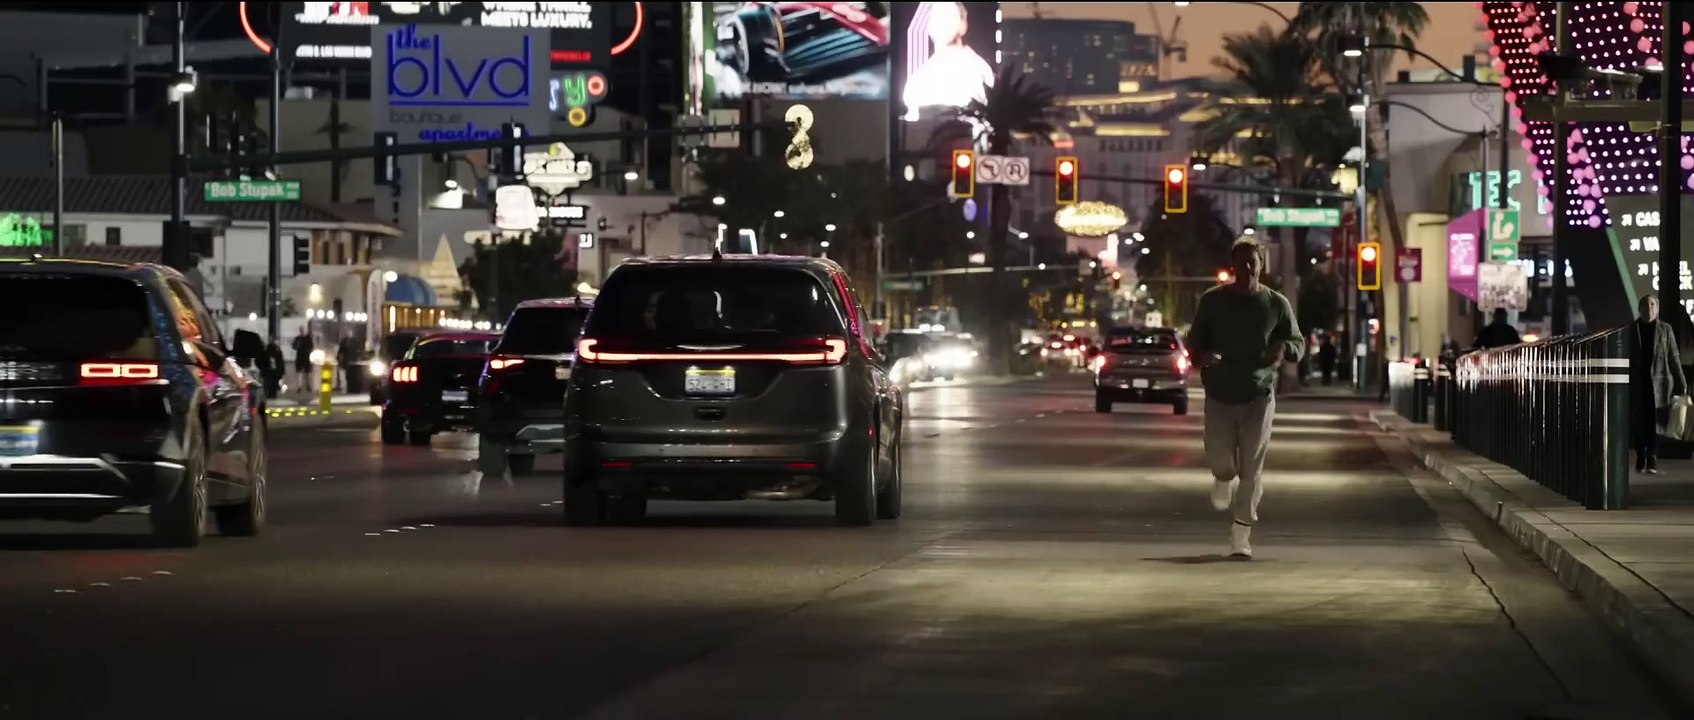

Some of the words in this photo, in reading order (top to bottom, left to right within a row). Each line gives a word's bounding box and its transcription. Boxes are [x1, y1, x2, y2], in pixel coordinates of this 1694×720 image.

[396, 23, 432, 49] the
[387, 33, 531, 98] blvd
[211, 182, 236, 197] Bob
[240, 182, 284, 200] Stupak
